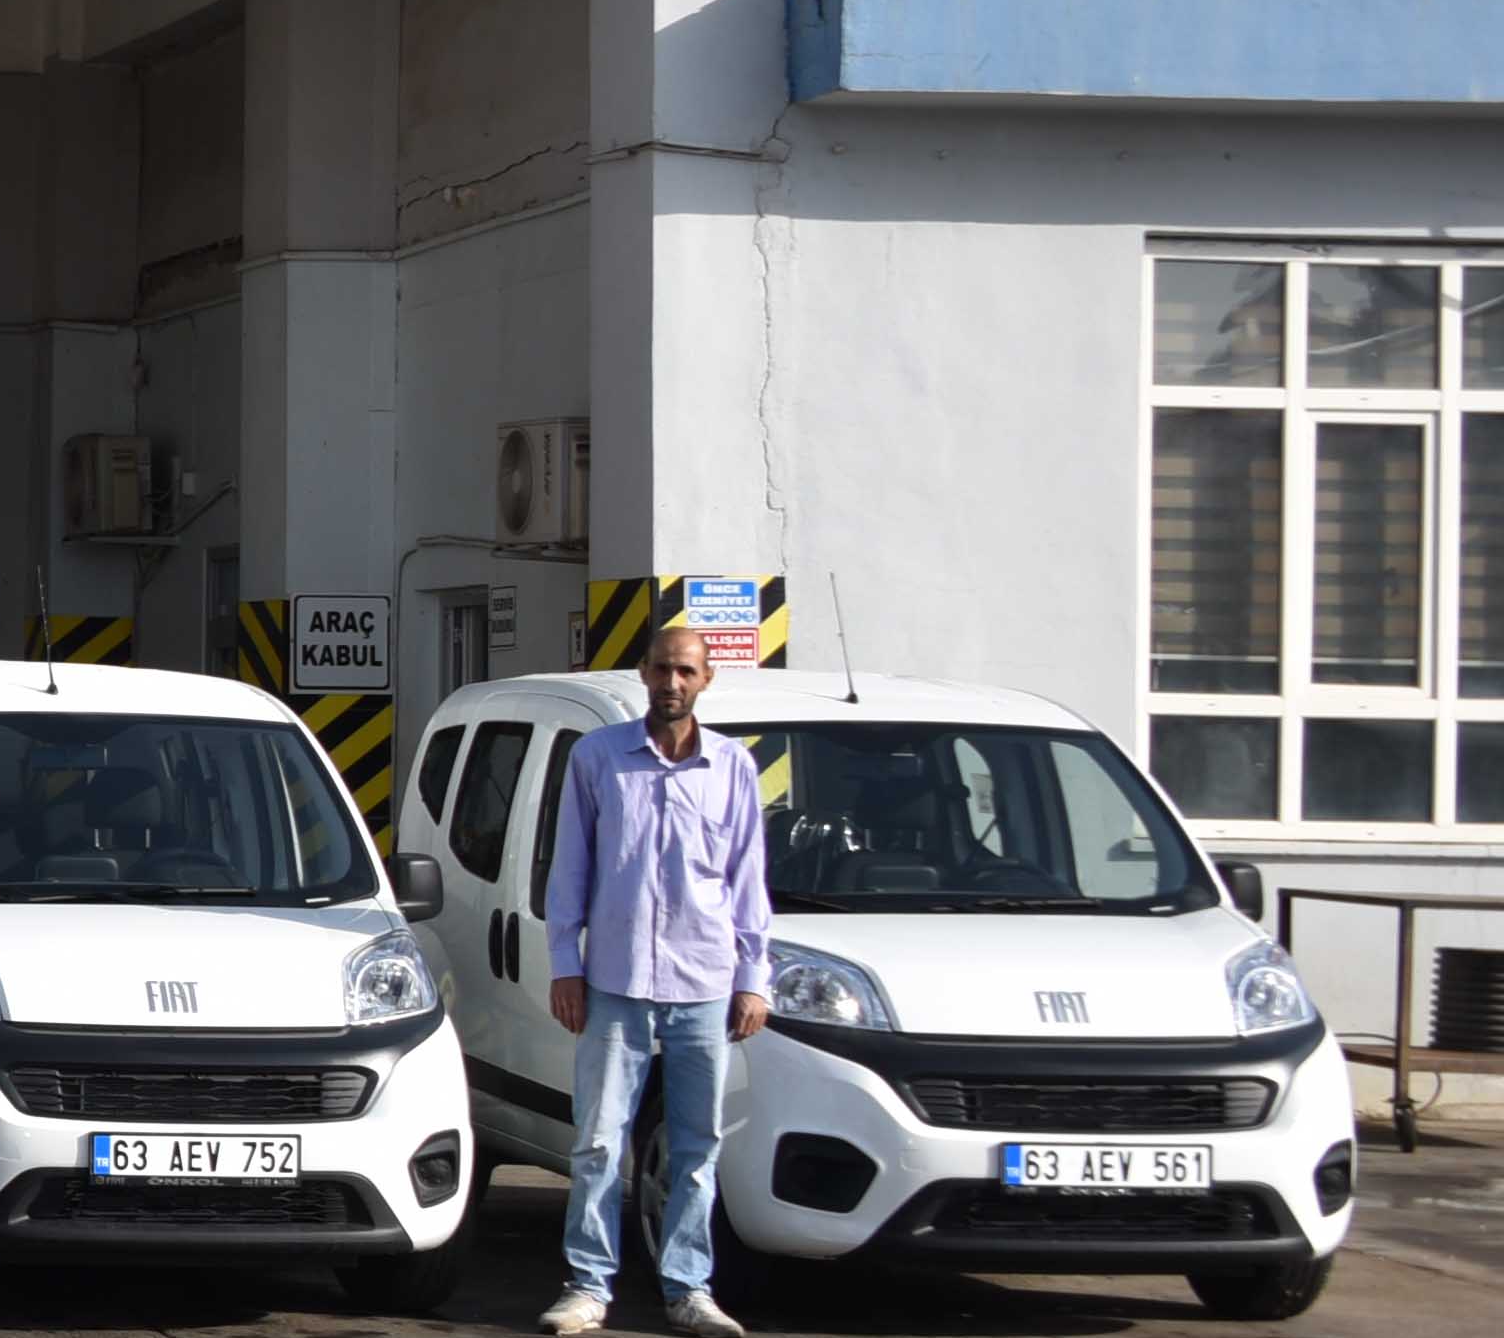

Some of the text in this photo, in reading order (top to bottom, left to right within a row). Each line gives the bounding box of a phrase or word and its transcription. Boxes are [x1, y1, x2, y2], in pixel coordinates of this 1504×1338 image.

[309, 611, 375, 638] ARAÇ
[302, 644, 383, 667] KABUL
[145, 980, 199, 1013] FIAT
[1034, 991, 1090, 1023] FIAT
[95, 1140, 294, 1174] TR 63 AEV 752
[1024, 1150, 1059, 1181] 63
[1081, 1151, 1133, 1182] AEV
[1154, 1152, 1203, 1183] 561
